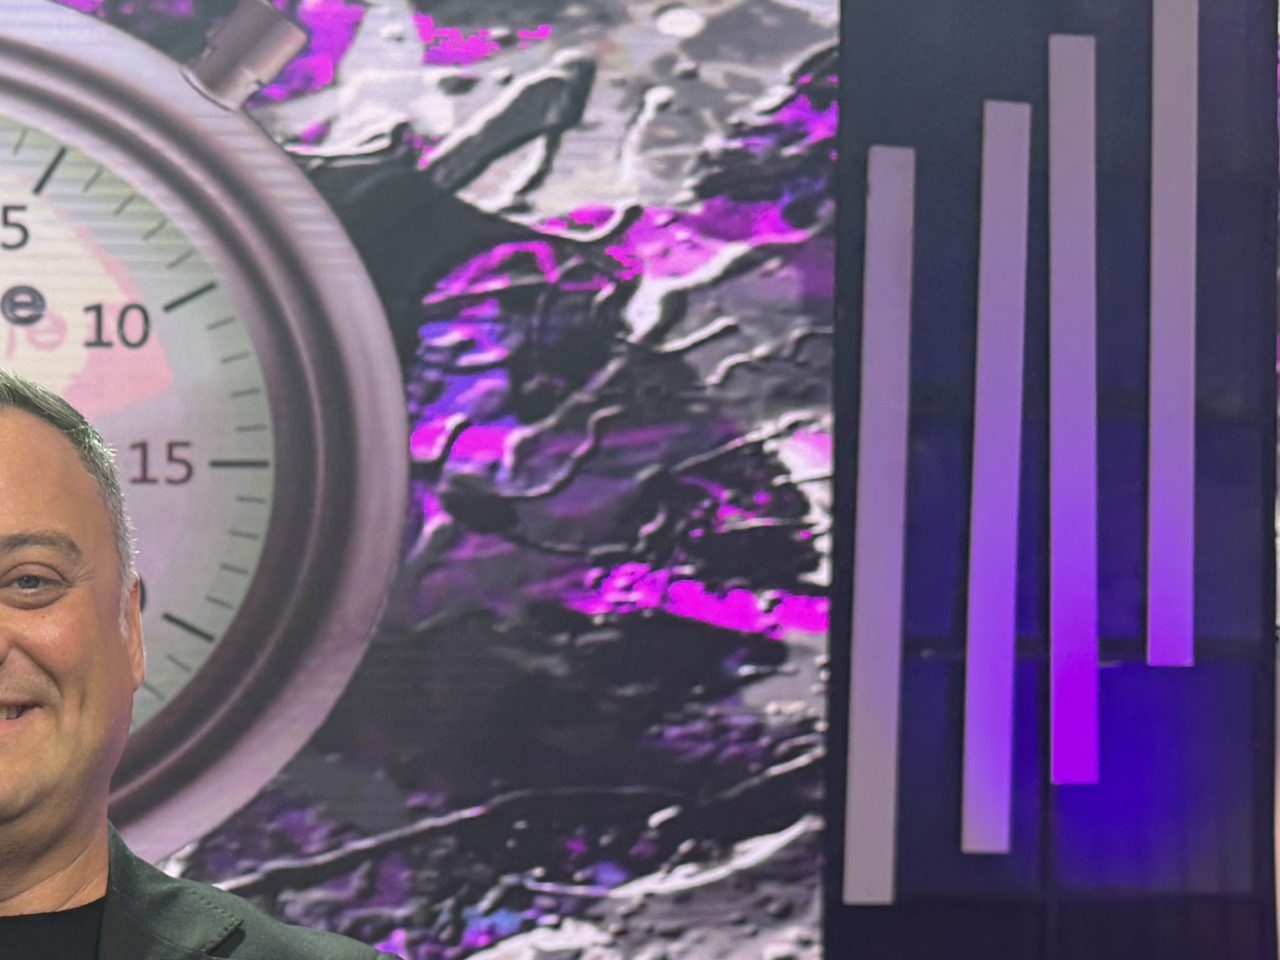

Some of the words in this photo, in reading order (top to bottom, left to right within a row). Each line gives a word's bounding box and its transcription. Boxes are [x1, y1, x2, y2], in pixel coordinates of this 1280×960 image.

[0, 204, 30, 250] 5
[82, 302, 151, 349] 10
[129, 440, 195, 486] 15
